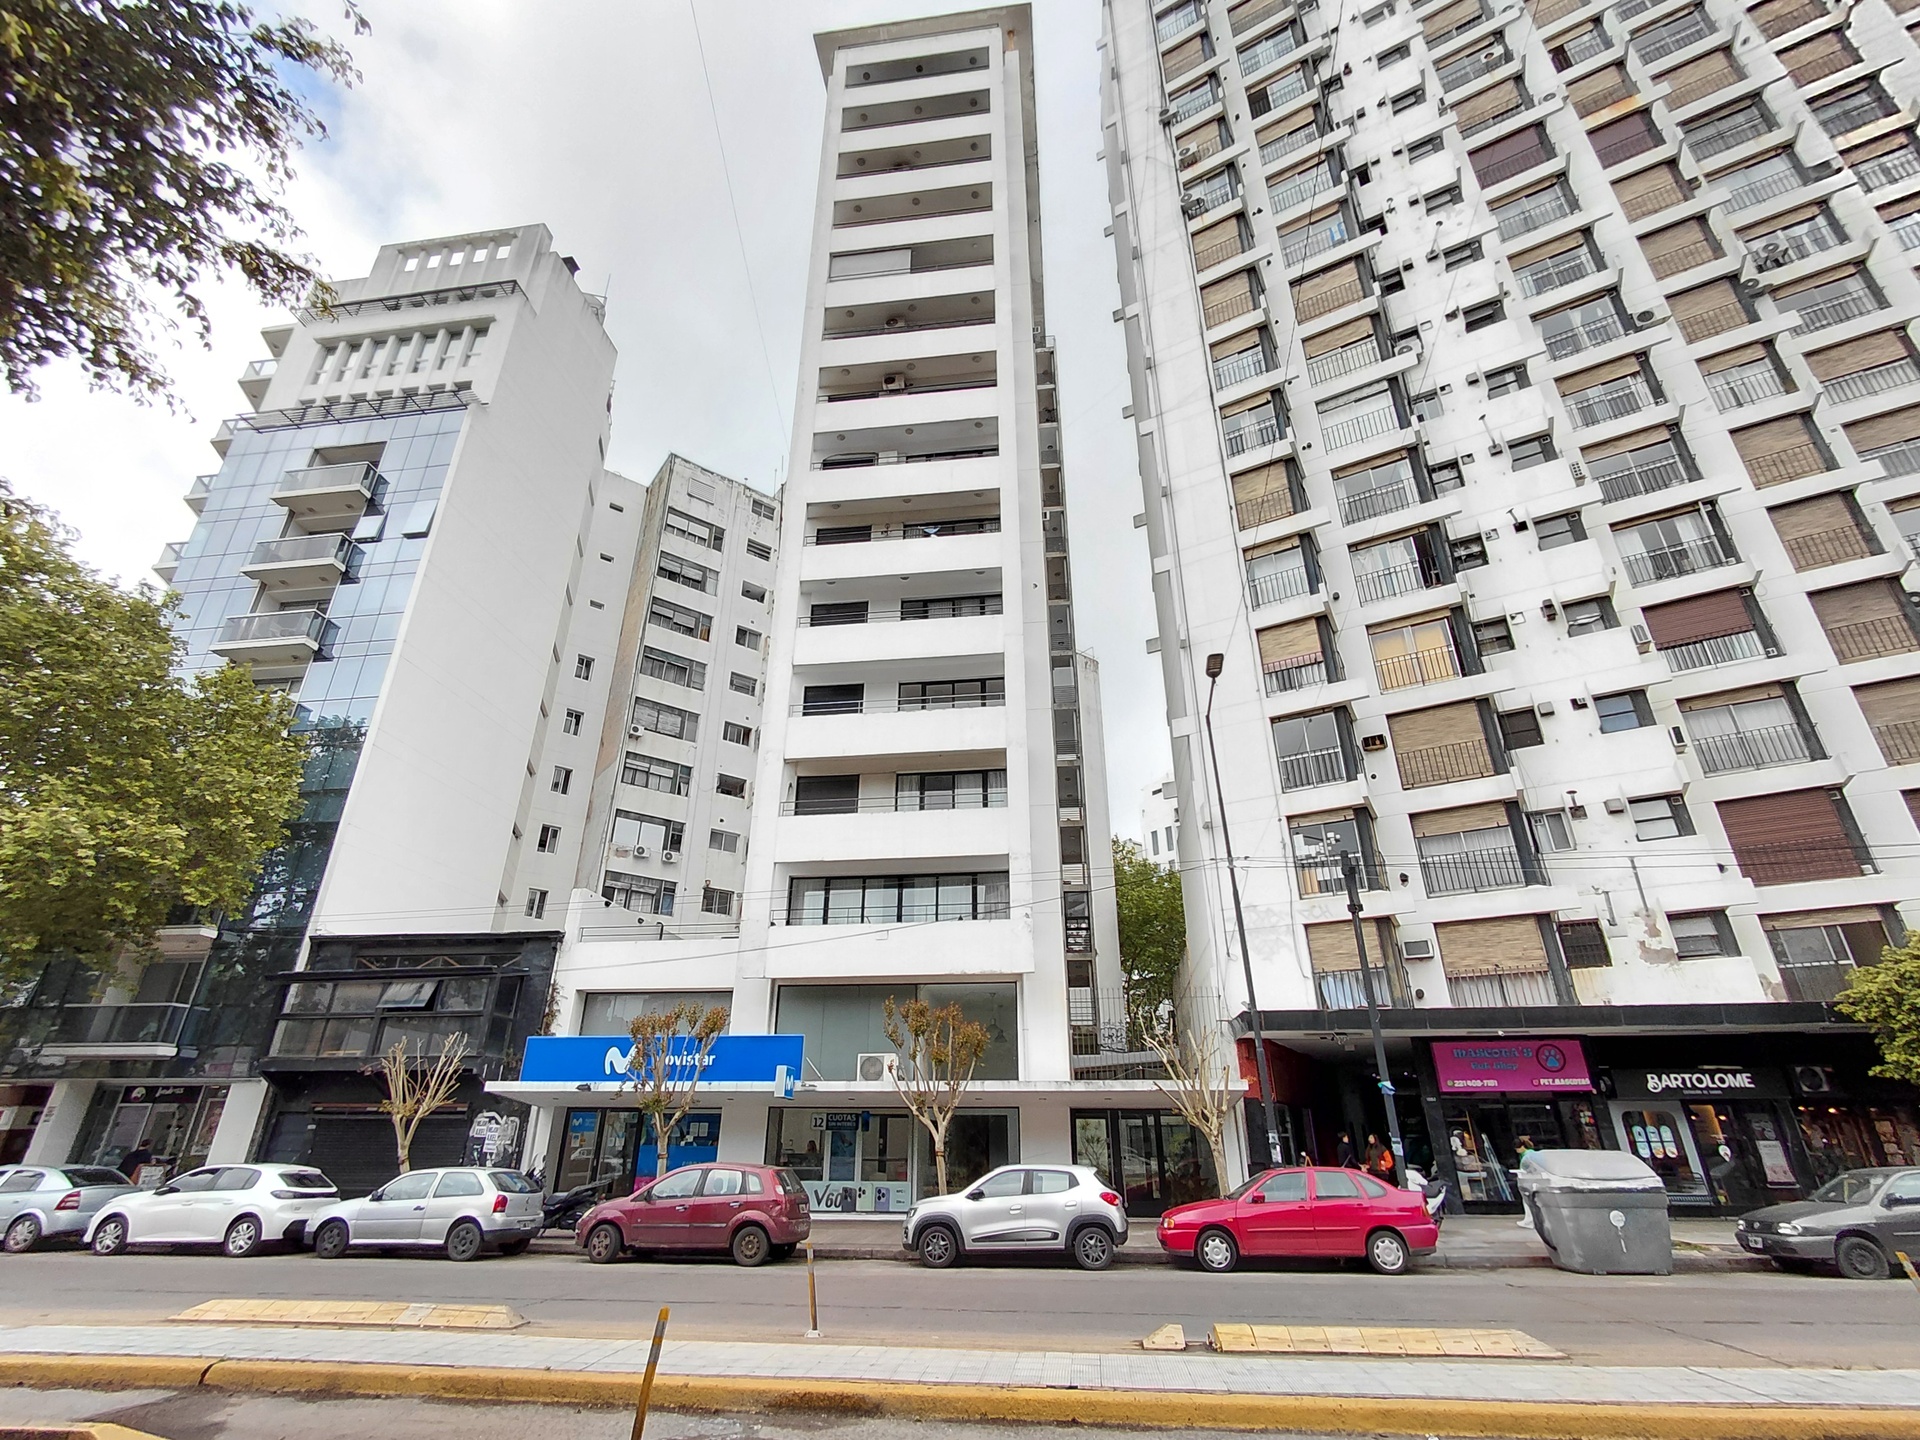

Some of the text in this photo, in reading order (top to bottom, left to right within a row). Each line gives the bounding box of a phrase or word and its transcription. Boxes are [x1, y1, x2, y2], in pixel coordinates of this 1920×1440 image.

[657, 1051, 716, 1067] ovistar
[1646, 1073, 1756, 1093] BARTOLOME
[813, 1117, 824, 1128] 12
